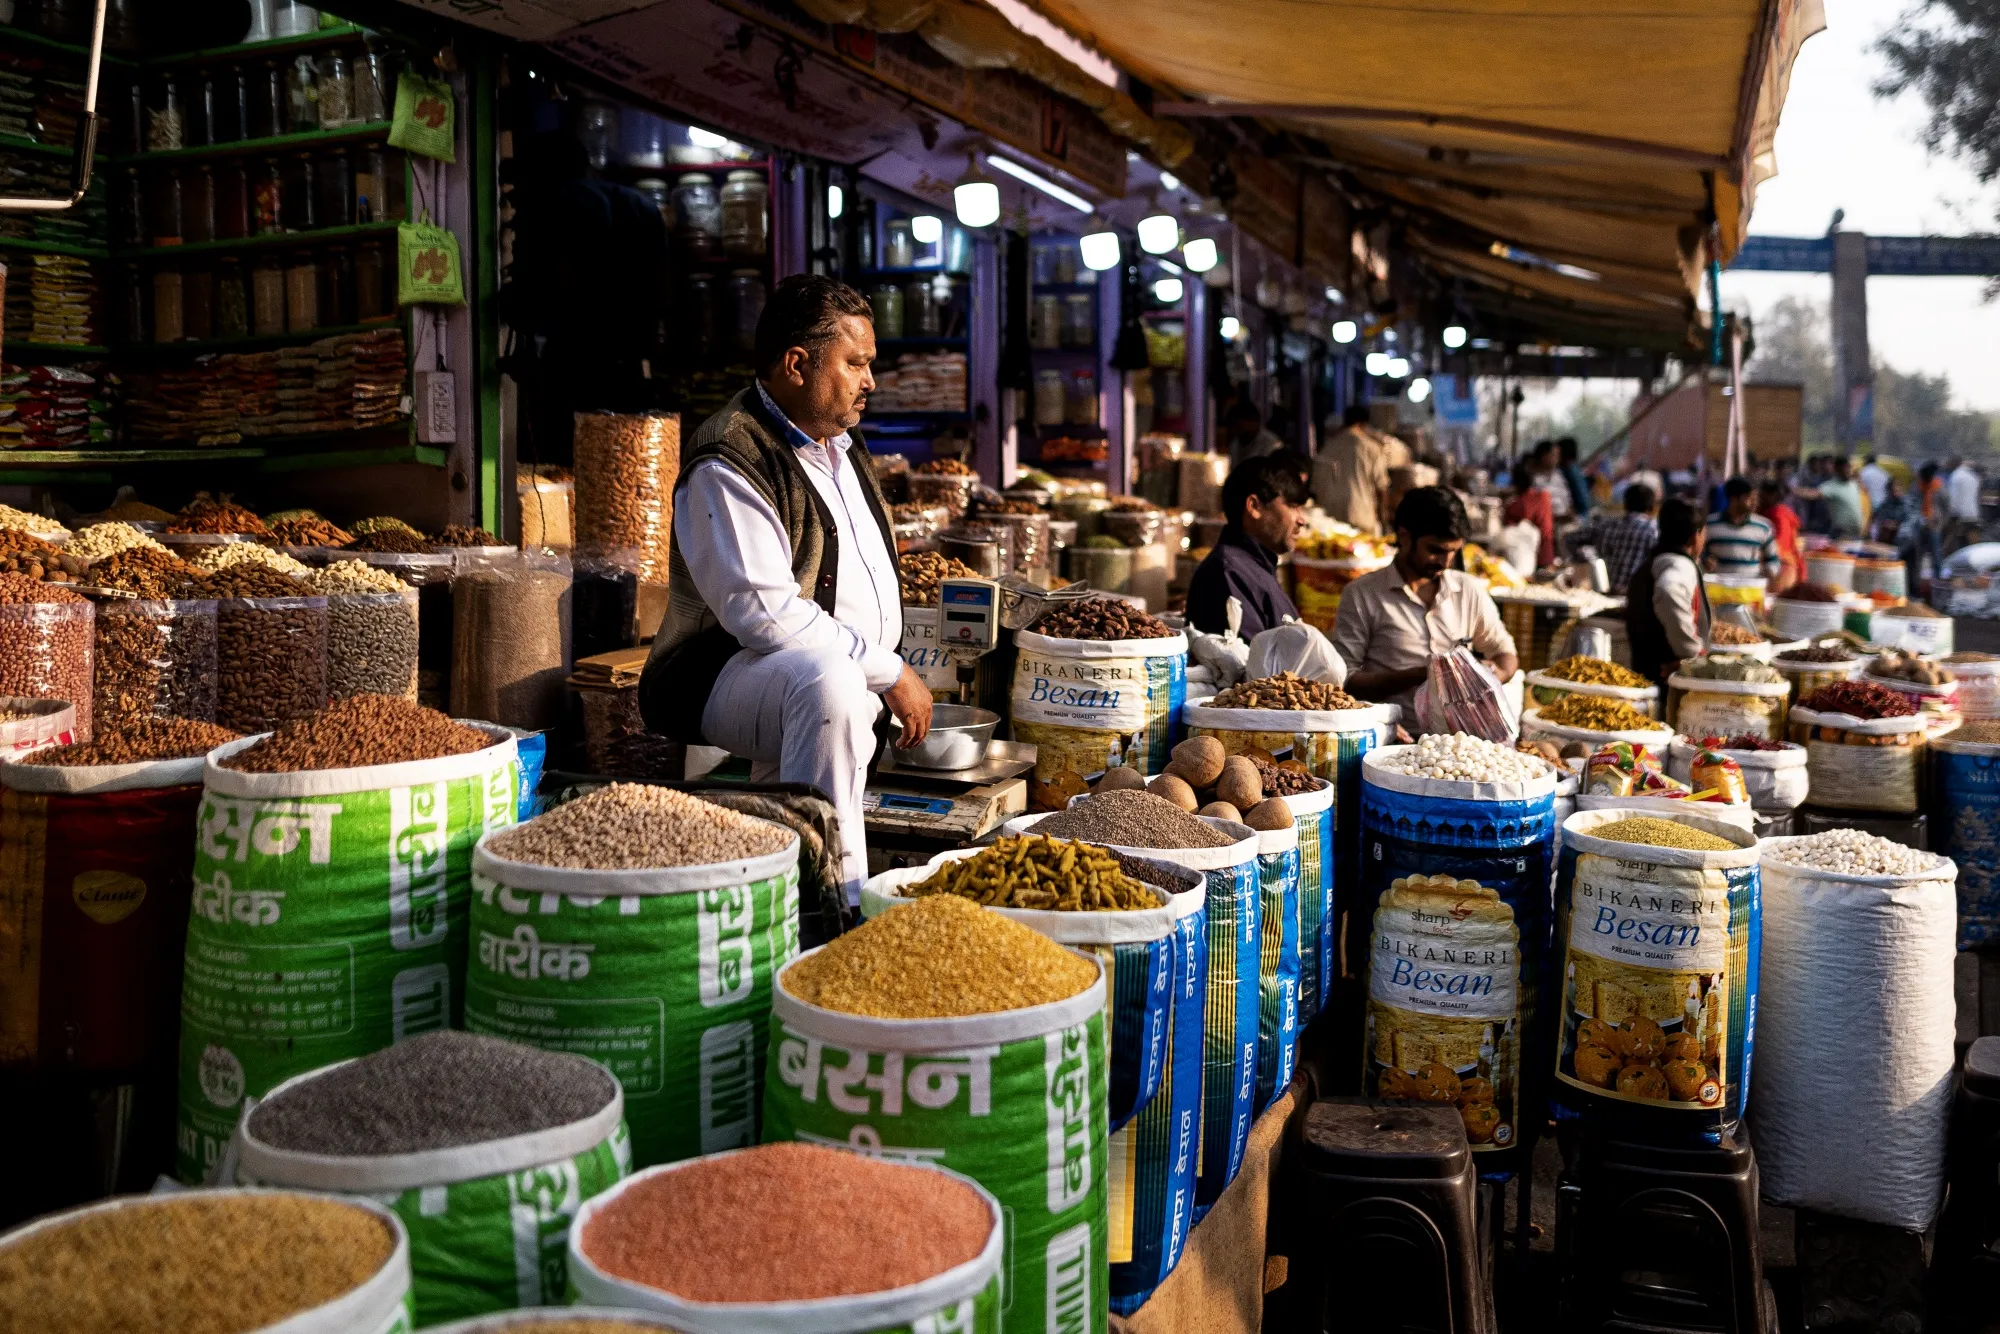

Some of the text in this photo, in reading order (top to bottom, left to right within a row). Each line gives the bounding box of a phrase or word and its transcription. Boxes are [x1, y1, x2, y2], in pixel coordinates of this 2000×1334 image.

[900, 647, 949, 667] san
[1022, 658, 1133, 680] BIKANERI
[1029, 677, 1121, 708] Besan
[1044, 710, 1068, 718] PREMIUM
[1583, 882, 1716, 915] BIKANERI
[1411, 909, 1450, 926] sharp
[1592, 905, 1700, 947] Besan
[478, 923, 596, 981] बारीक
[1381, 935, 1507, 964] BIKANERI
[1611, 945, 1674, 961] PREMIUM QUALITY
[1390, 957, 1494, 997] Besan
[1408, 997, 1469, 1010] PREMIUM QUALITY
[711, 1040, 747, 1128] MILL
[1239, 1042, 1254, 1101] बेसन
[1176, 1110, 1192, 1176] बेसन
